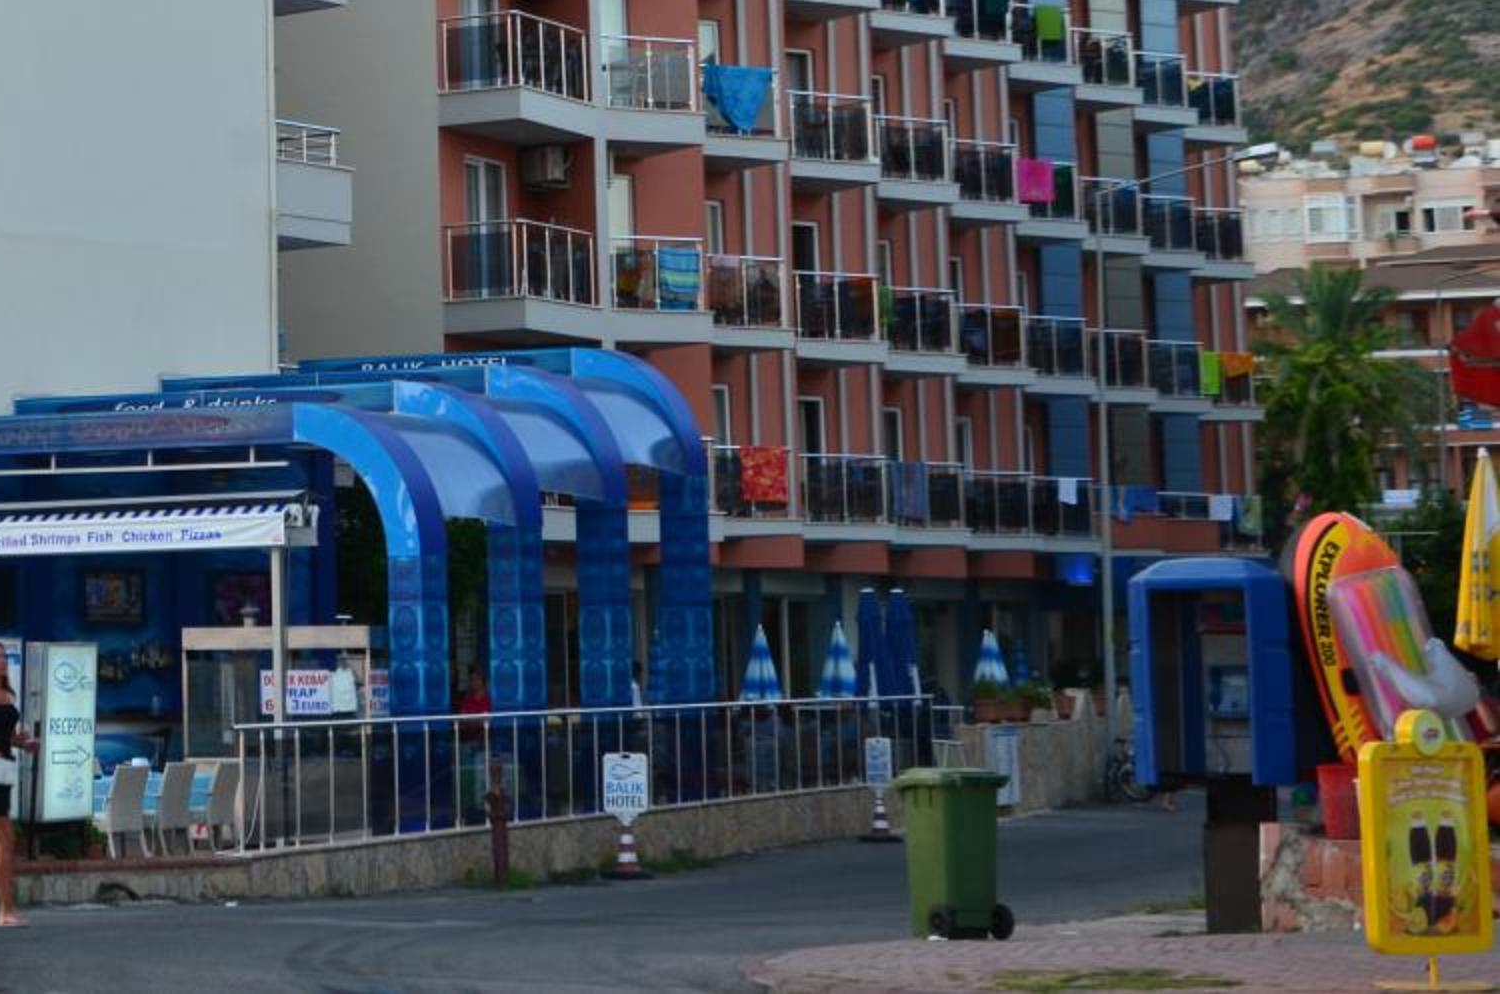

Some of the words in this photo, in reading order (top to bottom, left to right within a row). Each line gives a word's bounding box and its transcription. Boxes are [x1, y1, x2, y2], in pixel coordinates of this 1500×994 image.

[87, 530, 113, 543] Fish
[121, 529, 173, 543] Chicken
[1315, 539, 1340, 638] EXPLORER
[1319, 639, 1336, 667] 200
[606, 782, 645, 794] BALIK
[606, 795, 645, 808] HOTEL
